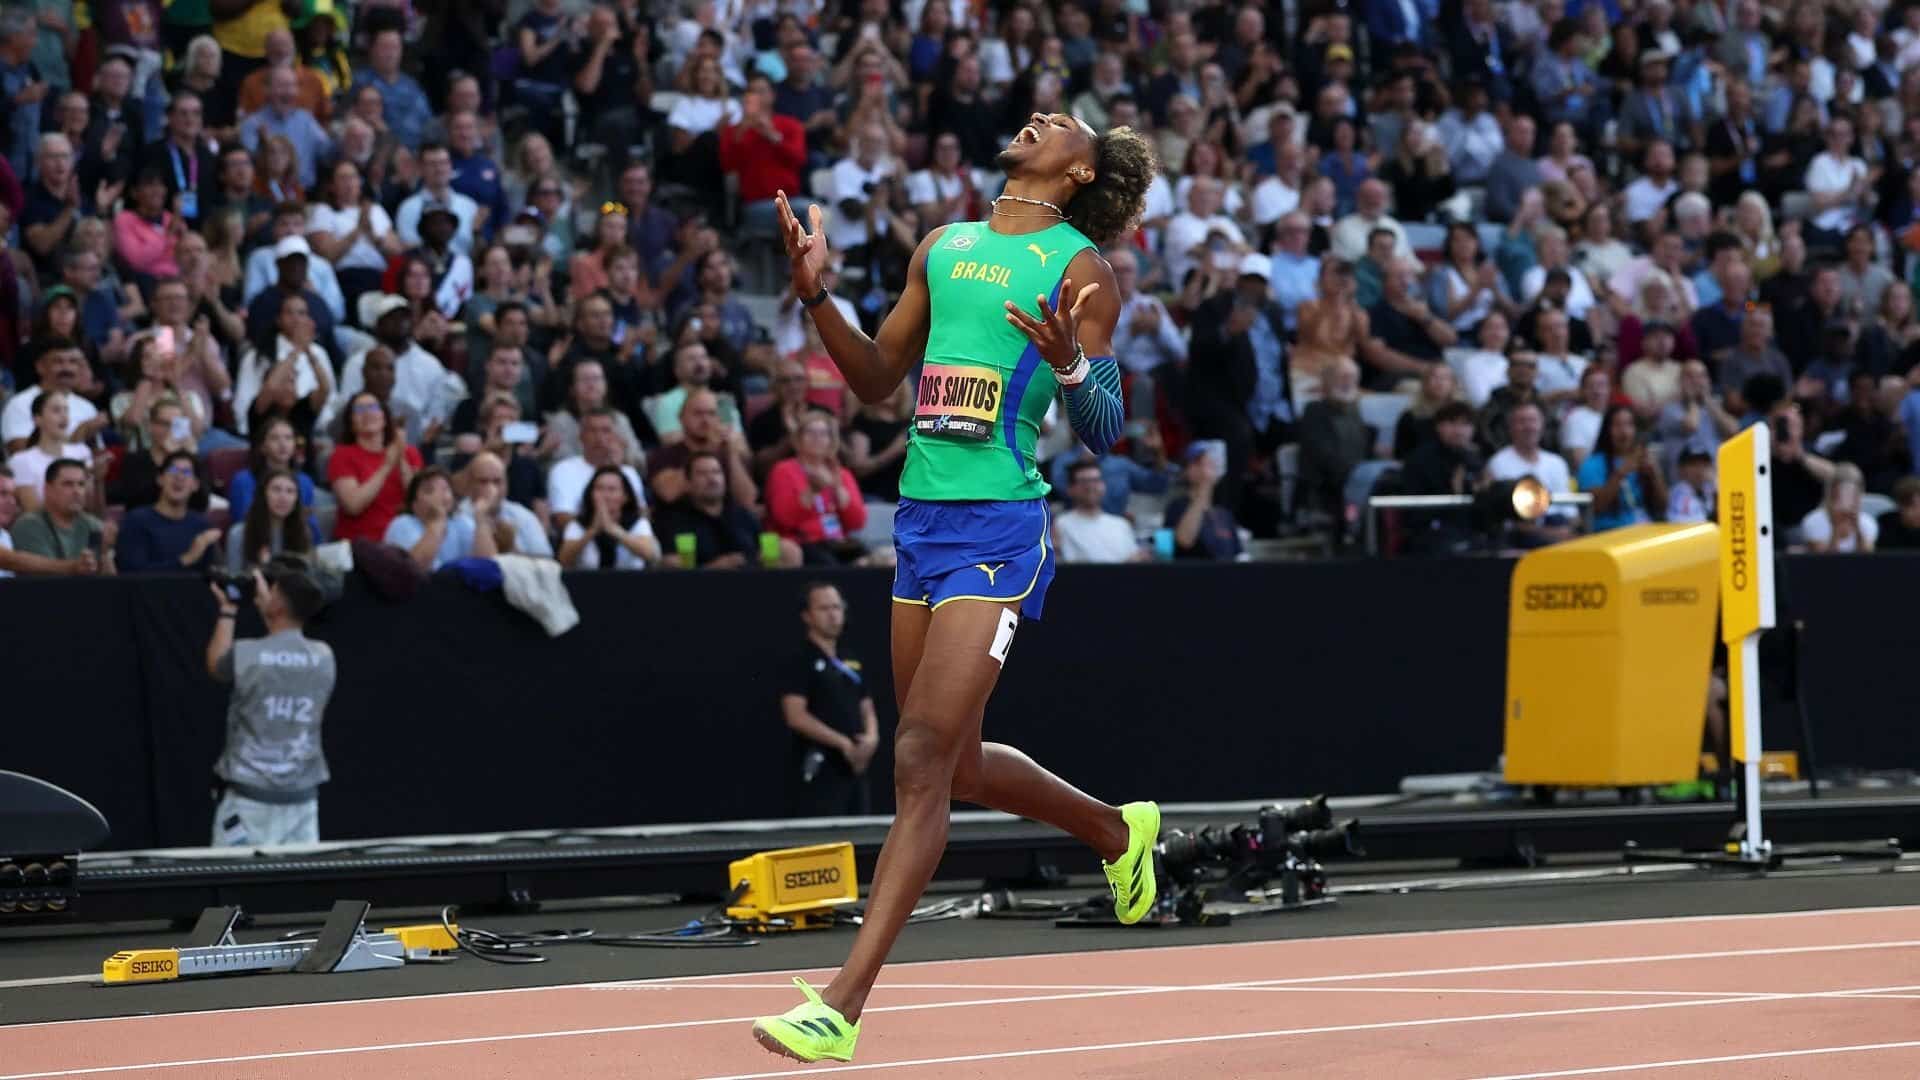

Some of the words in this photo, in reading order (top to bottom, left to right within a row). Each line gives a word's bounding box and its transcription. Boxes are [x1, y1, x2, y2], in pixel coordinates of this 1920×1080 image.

[951, 261, 1012, 287] BRASIL
[920, 375, 942, 407] DOS
[943, 376, 998, 412] SANTOS
[1731, 491, 1747, 591] SEIKO
[1524, 582, 1608, 611] SEIKO
[263, 696, 314, 722] 142
[784, 867, 841, 889] SEIKO
[131, 959, 174, 974] SEIKO
